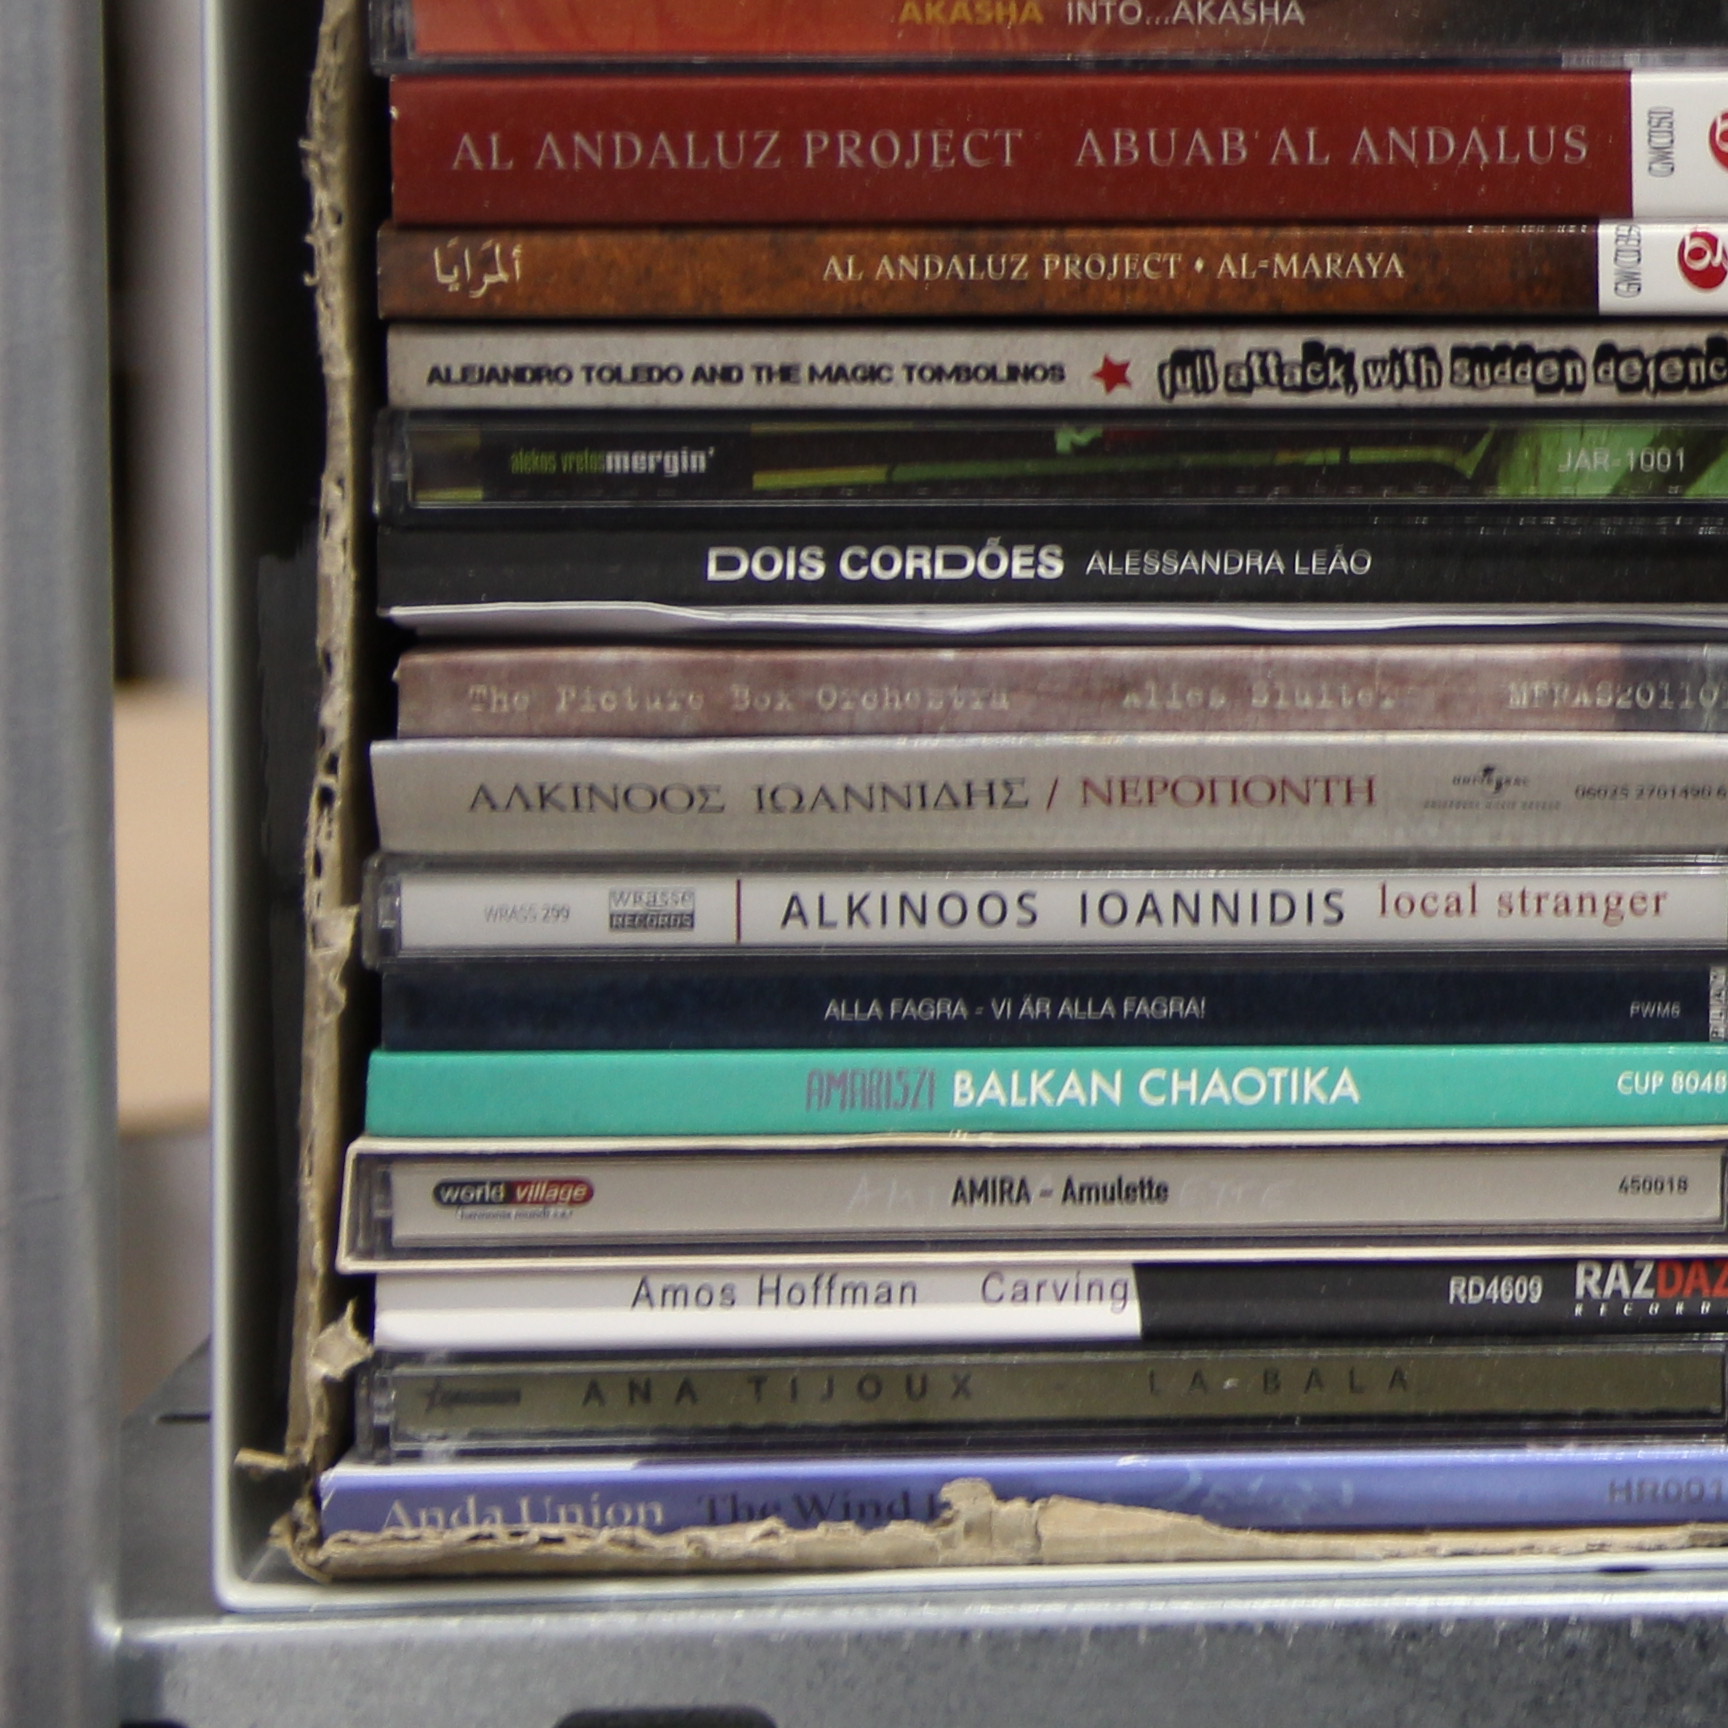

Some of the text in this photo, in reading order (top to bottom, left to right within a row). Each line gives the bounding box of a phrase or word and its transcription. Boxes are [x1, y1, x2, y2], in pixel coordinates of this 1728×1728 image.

[452, 134, 512, 169] AL
[535, 131, 781, 169] ANDALUZ
[806, 130, 1022, 167] PROJECT
[1271, 130, 1330, 163] AL
[1350, 127, 1589, 164] ANDALUS
[426, 364, 1065, 386] ALEJANDRO TOLEDO AND THE MAGIC TOMBOLINOS
[1558, 448, 1686, 473] JAR-1001
[708, 537, 1371, 582] DOIS CORDÕES ALESSANDRA LEÃO
[781, 883, 1668, 930] ALKINOOS IOANNIDIS local stranger
[952, 1067, 1360, 1107] BALKAN CHAOTIKA
[952, 1176, 1169, 1207] AMIRA Amulette
[1618, 1177, 1689, 1195] 450018
[632, 1277, 736, 1309] Amos
[758, 1276, 918, 1307] Hoffman
[982, 1272, 1129, 1311] Carving
[1449, 1277, 1542, 1304] RD4609
